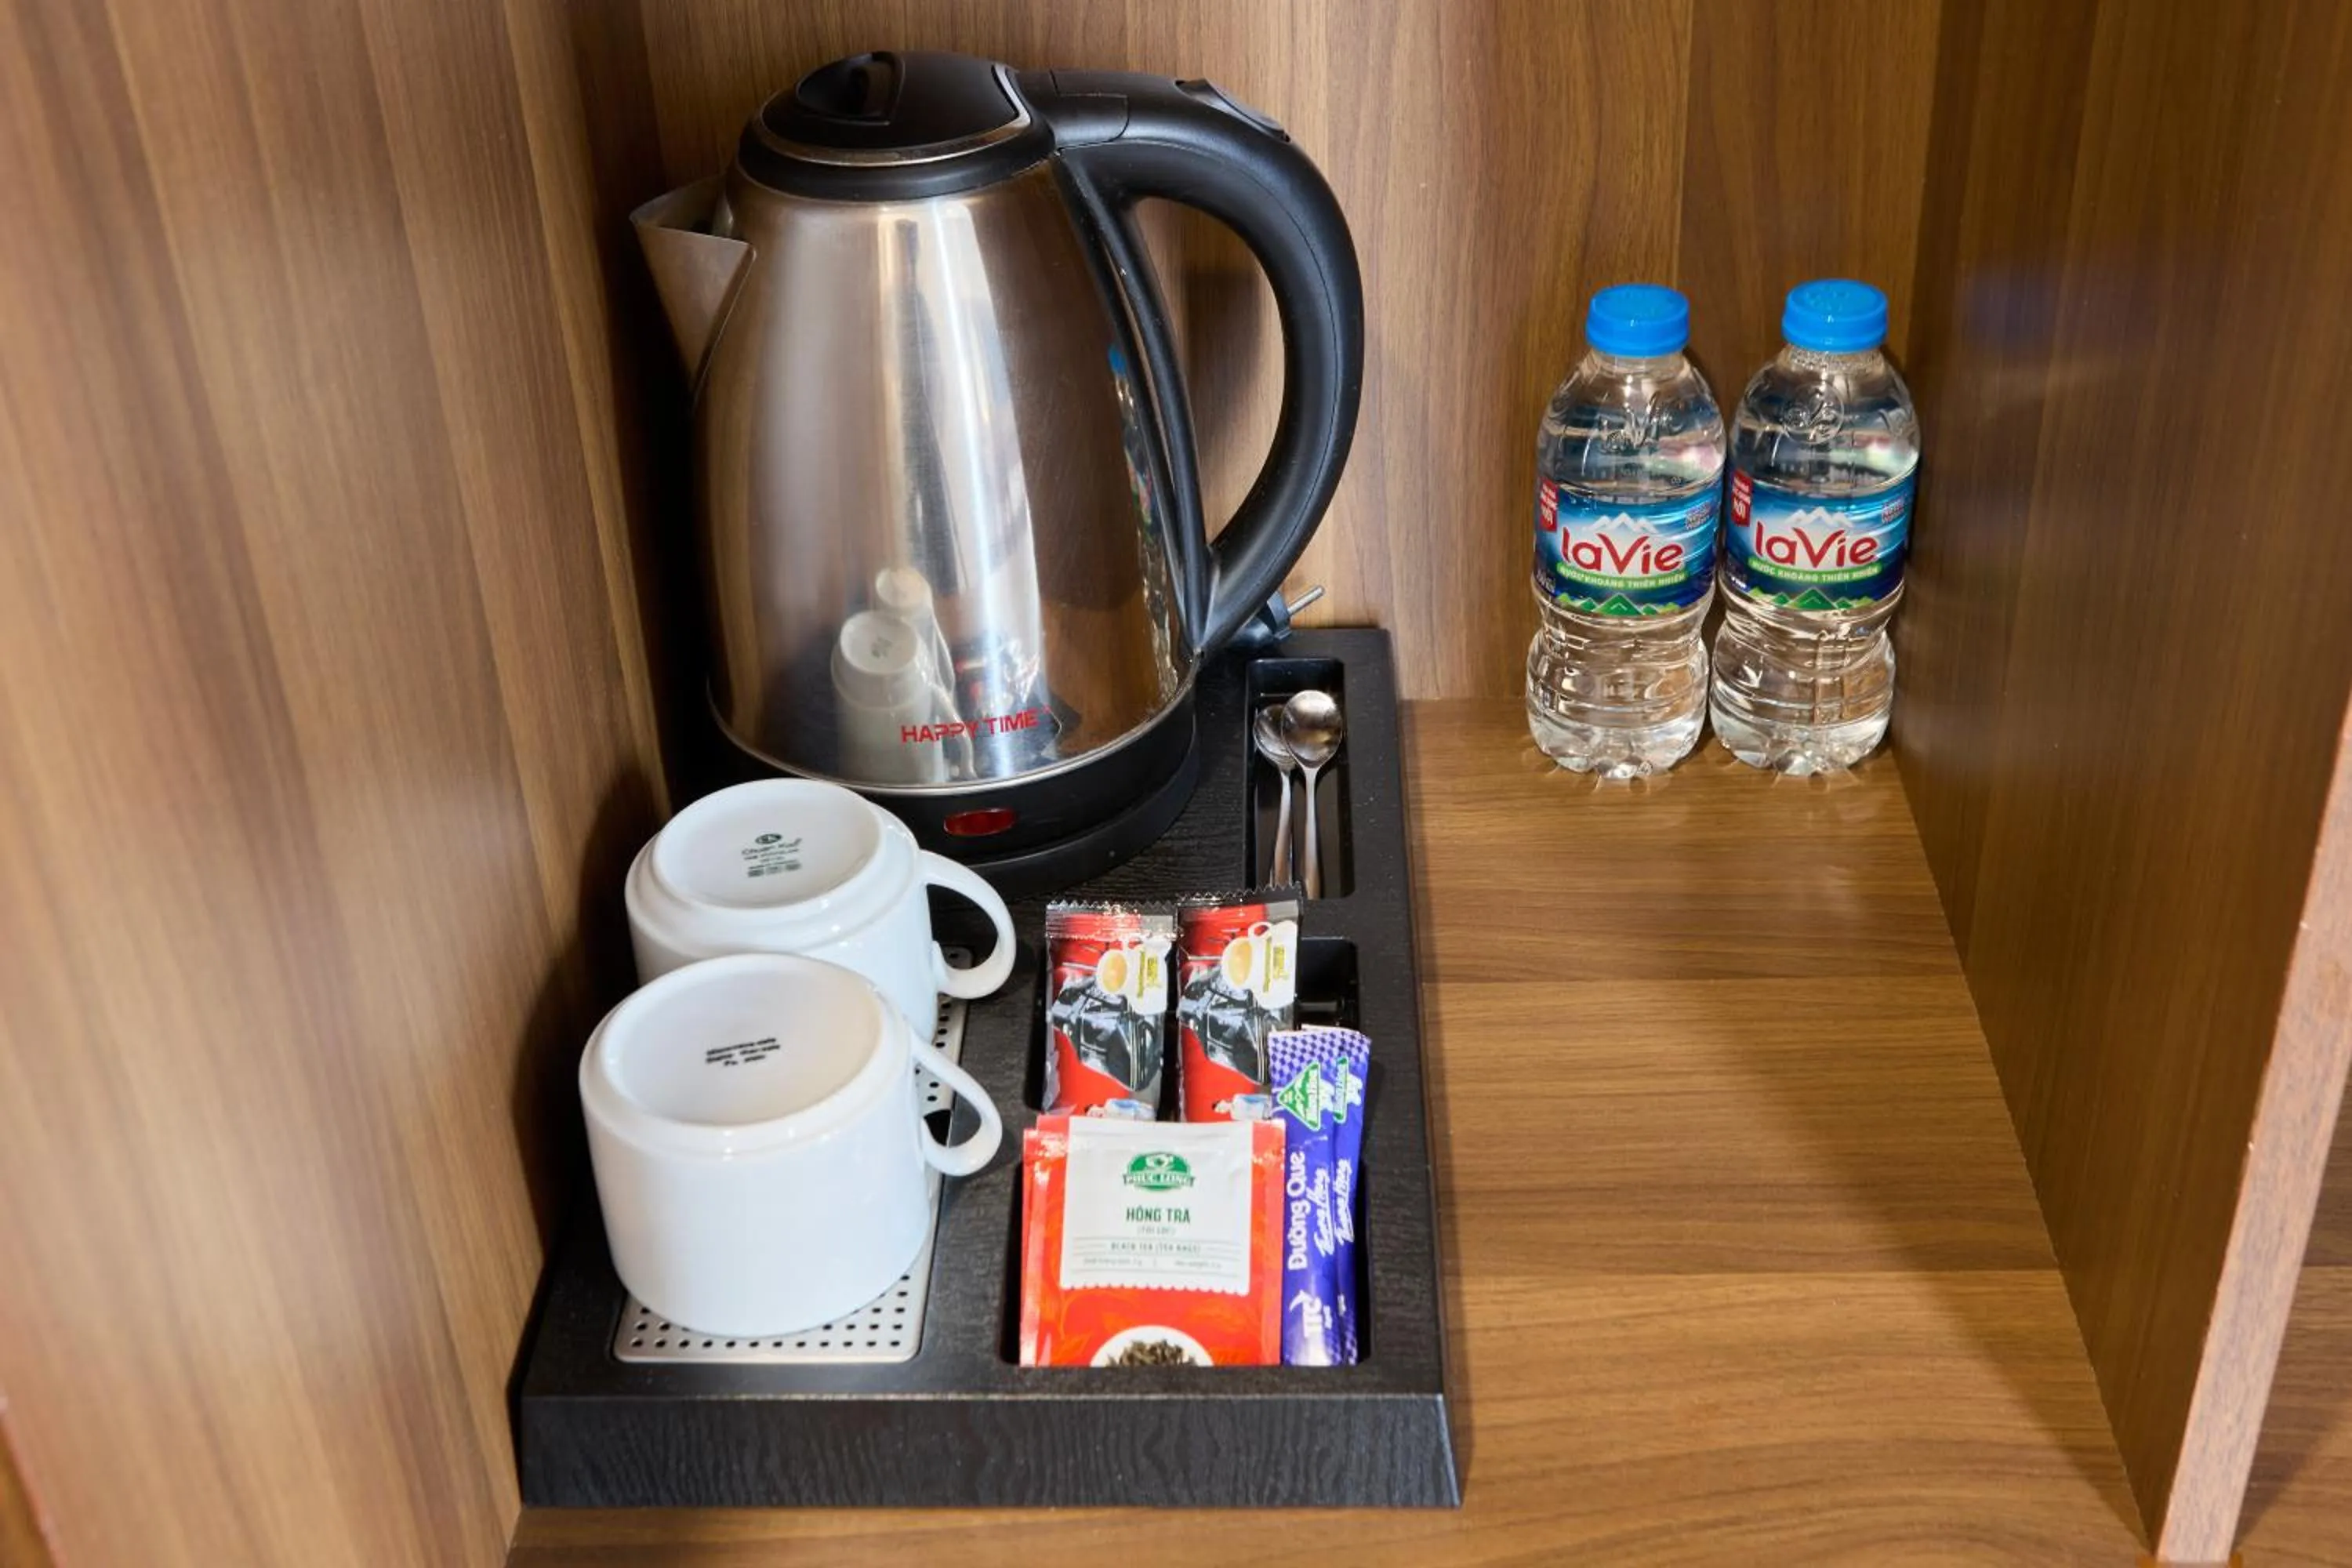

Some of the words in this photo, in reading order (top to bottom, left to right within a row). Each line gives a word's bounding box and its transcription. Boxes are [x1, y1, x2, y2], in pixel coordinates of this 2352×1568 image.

[901, 720, 979, 743] HAPPY
[984, 709, 1039, 735] TIME
[1287, 1151, 1307, 1198] Que
